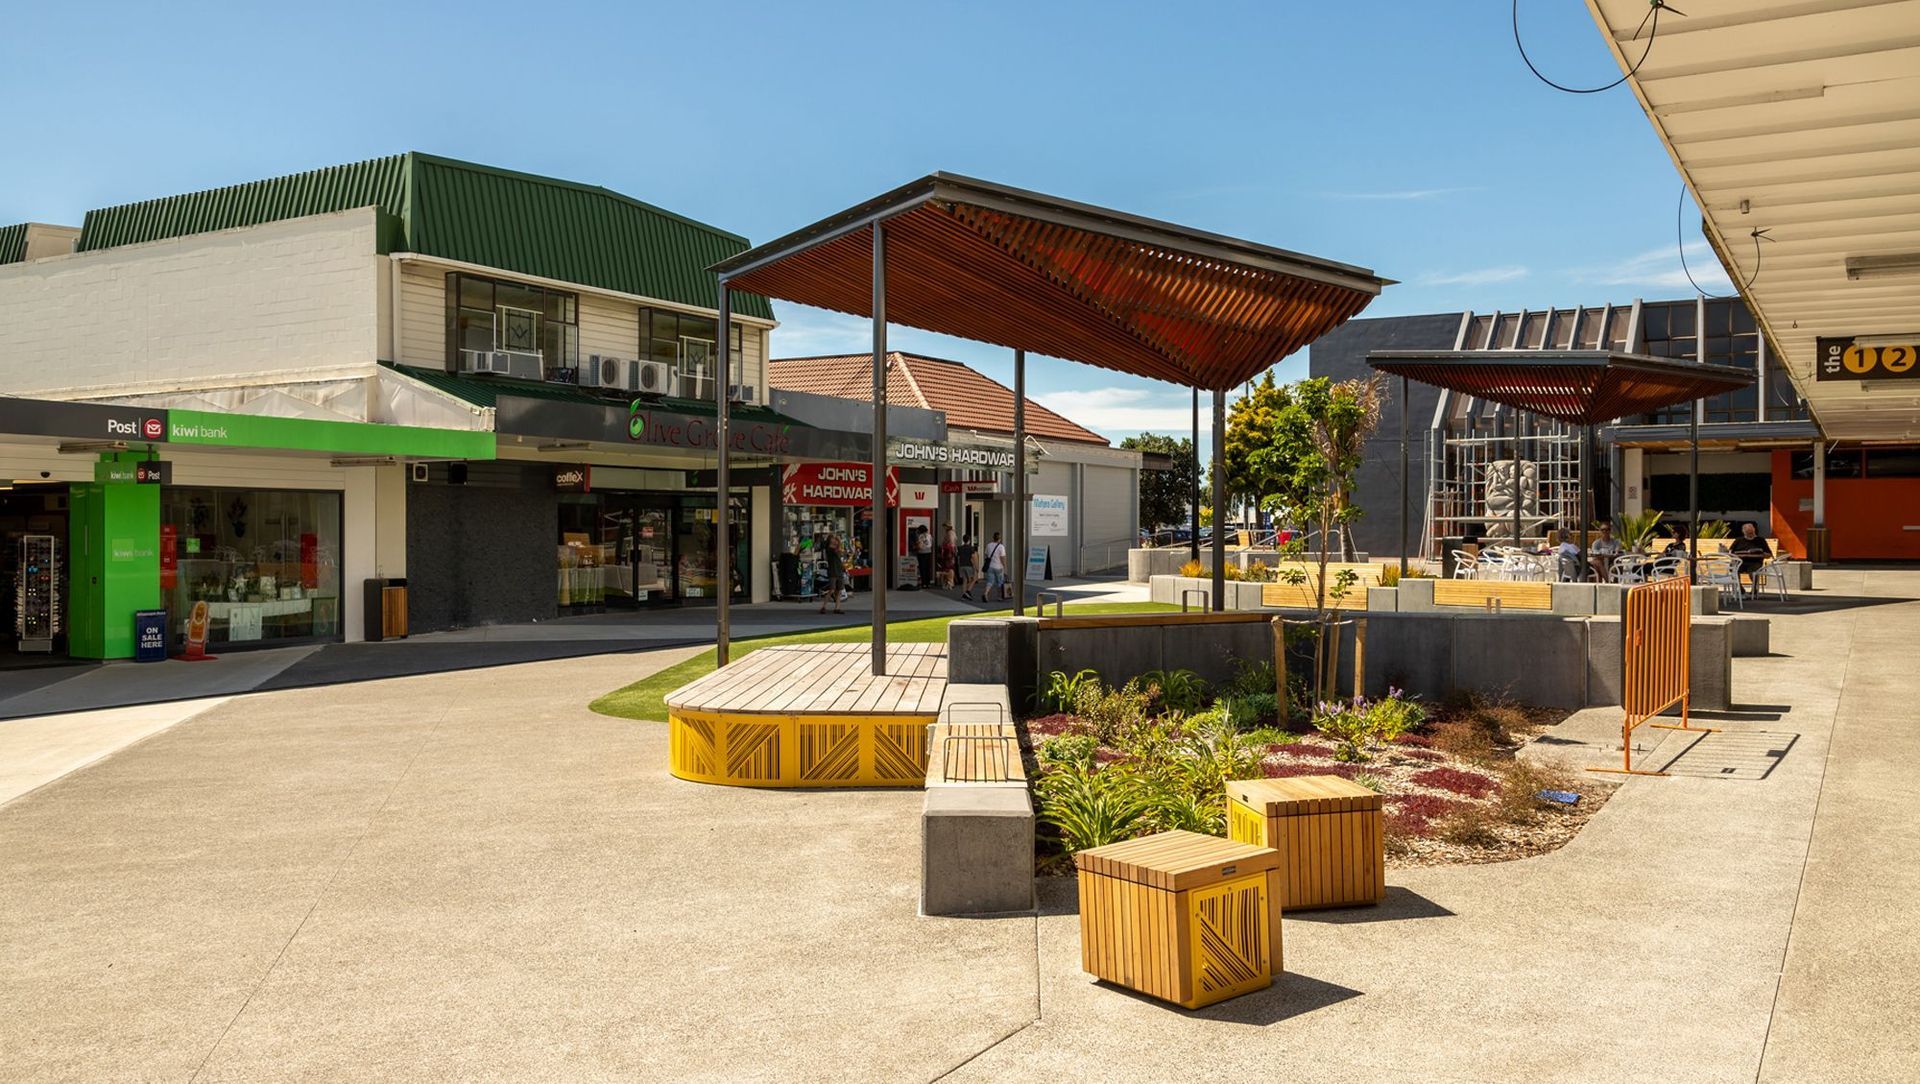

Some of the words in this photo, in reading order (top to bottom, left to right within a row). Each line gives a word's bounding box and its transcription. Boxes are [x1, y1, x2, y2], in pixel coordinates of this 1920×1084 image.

[1824, 345, 1841, 373] the
[1890, 347, 1907, 367] 2
[107, 418, 137, 434] Post
[172, 423, 198, 437] kiwi
[200, 424, 227, 438] bank
[687, 420, 745, 449] Groe
[896, 443, 948, 461] JOHN'S
[952, 448, 1016, 467] HARDWAR
[147, 470, 160, 480] Post
[818, 467, 867, 482] JOHN'S
[803, 484, 873, 500] HARDWAR
[142, 633, 162, 641] SALE
[141, 641, 162, 649] HERE
